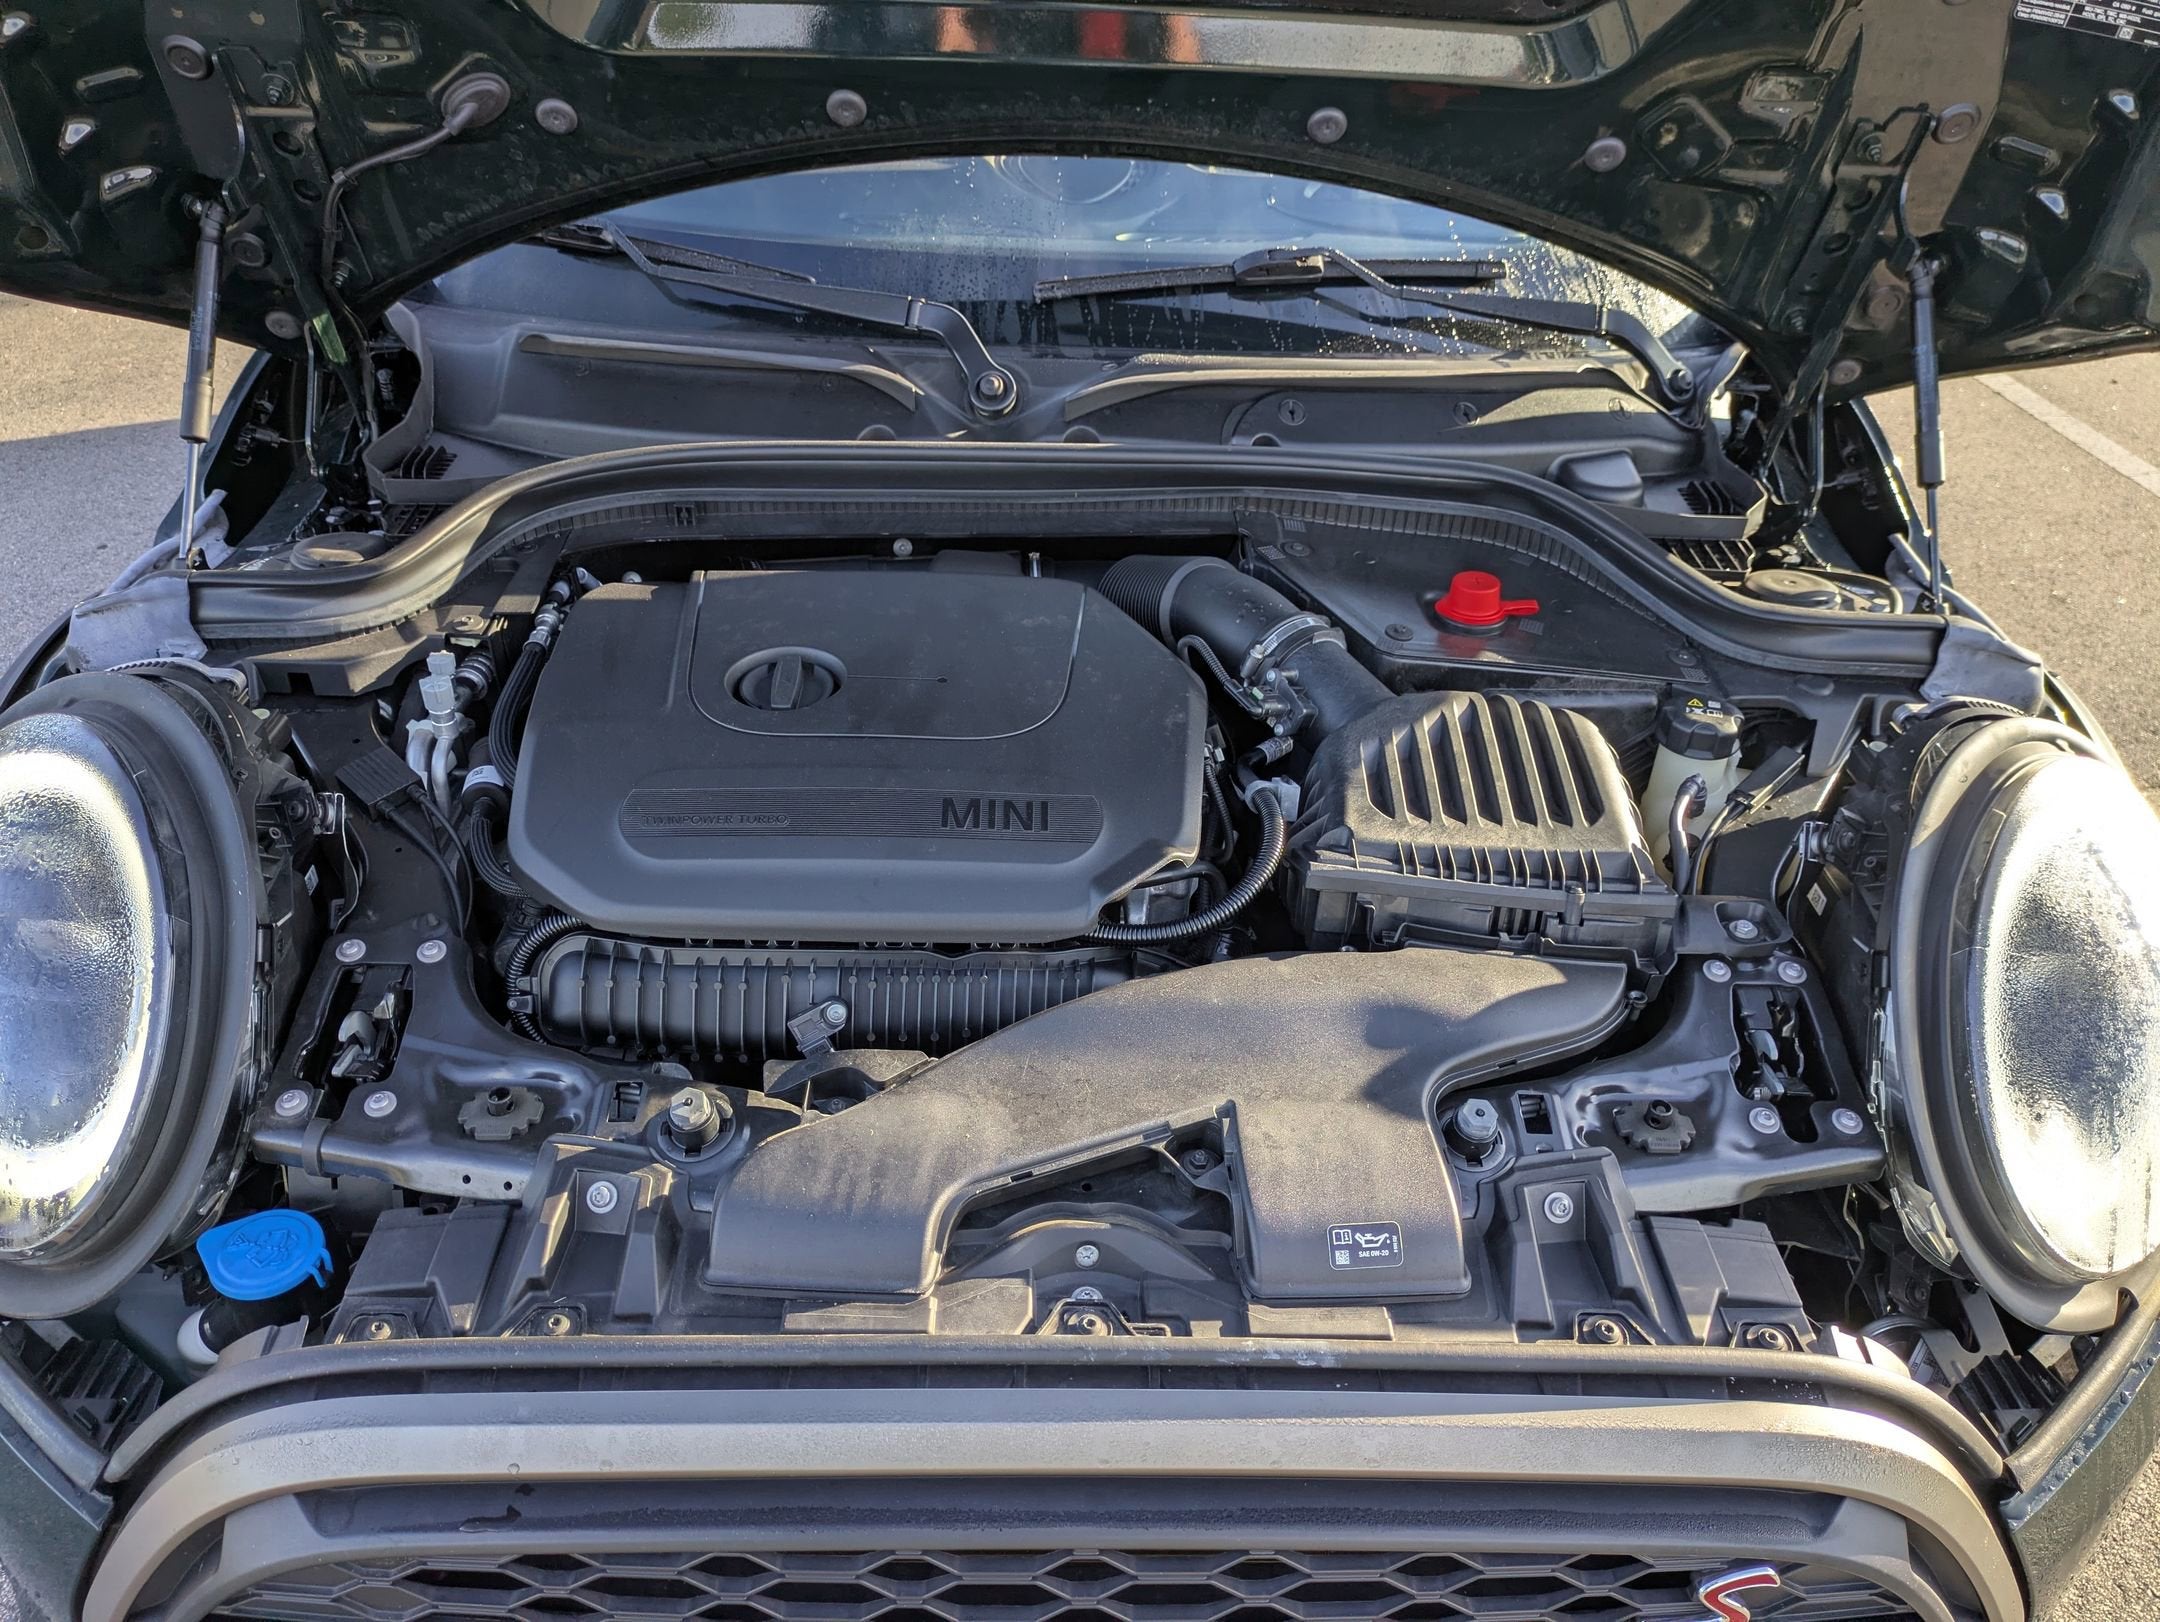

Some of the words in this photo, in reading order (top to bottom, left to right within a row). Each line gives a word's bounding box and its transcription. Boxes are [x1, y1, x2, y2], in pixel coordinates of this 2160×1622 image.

[642, 814, 733, 826] TWINPOWER
[738, 813, 788, 825] TURBO
[941, 797, 1049, 832] MINI
[1370, 1249, 1389, 1257] 0W-20
